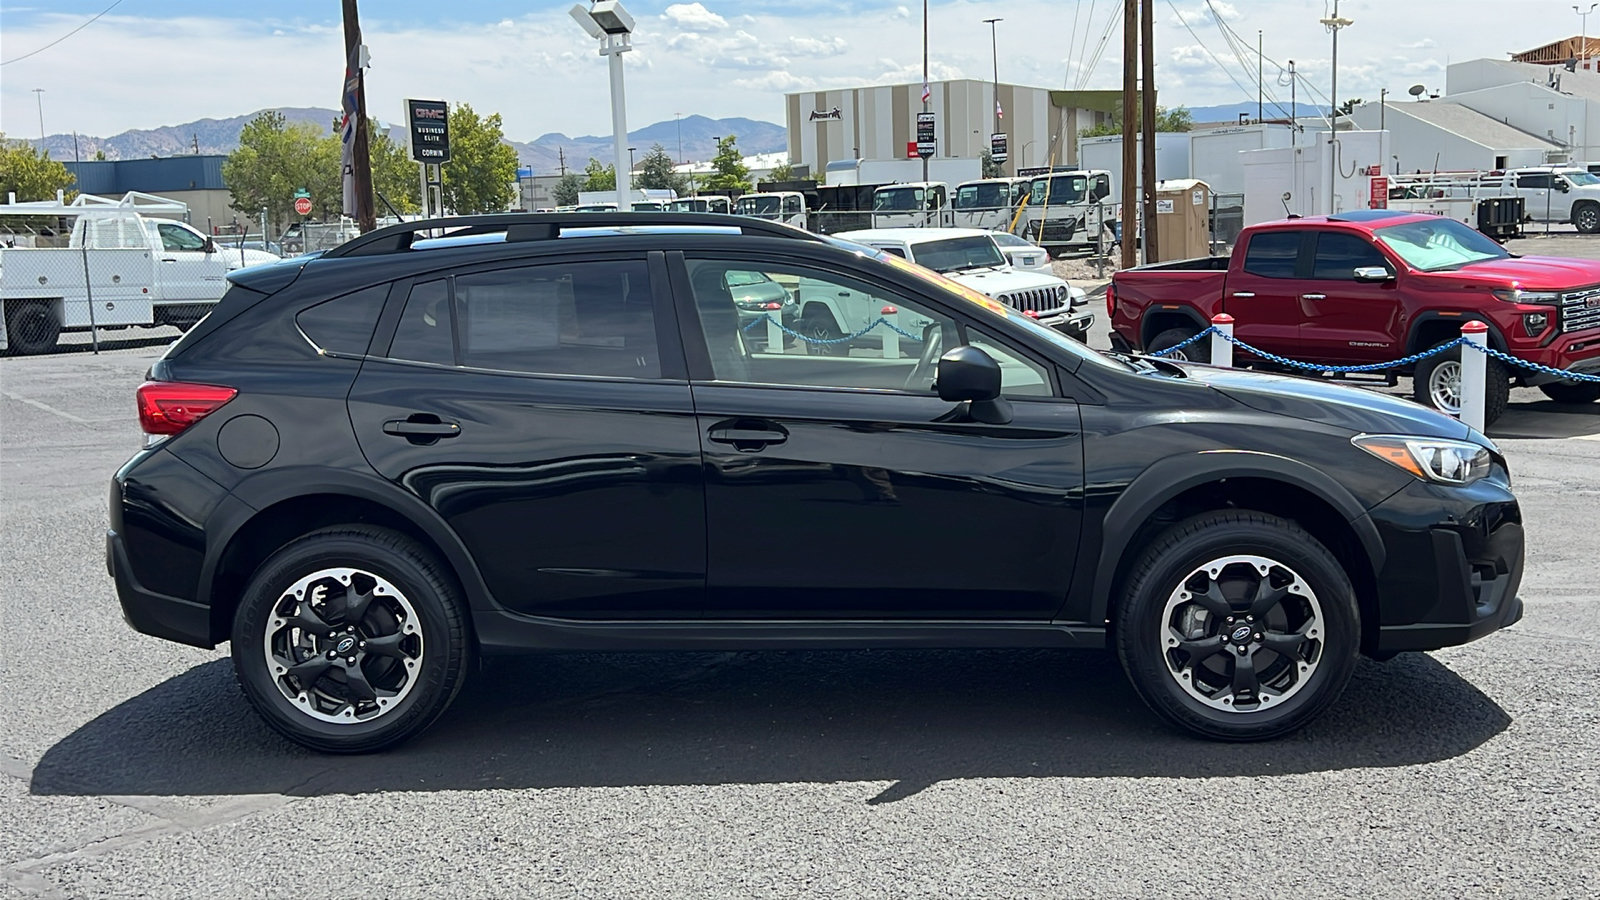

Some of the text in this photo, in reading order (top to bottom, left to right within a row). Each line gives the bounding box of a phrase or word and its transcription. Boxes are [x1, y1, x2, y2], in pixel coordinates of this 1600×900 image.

[415, 108, 445, 119] GMC
[421, 149, 444, 157] CORWIN
[295, 202, 311, 210] STOP
